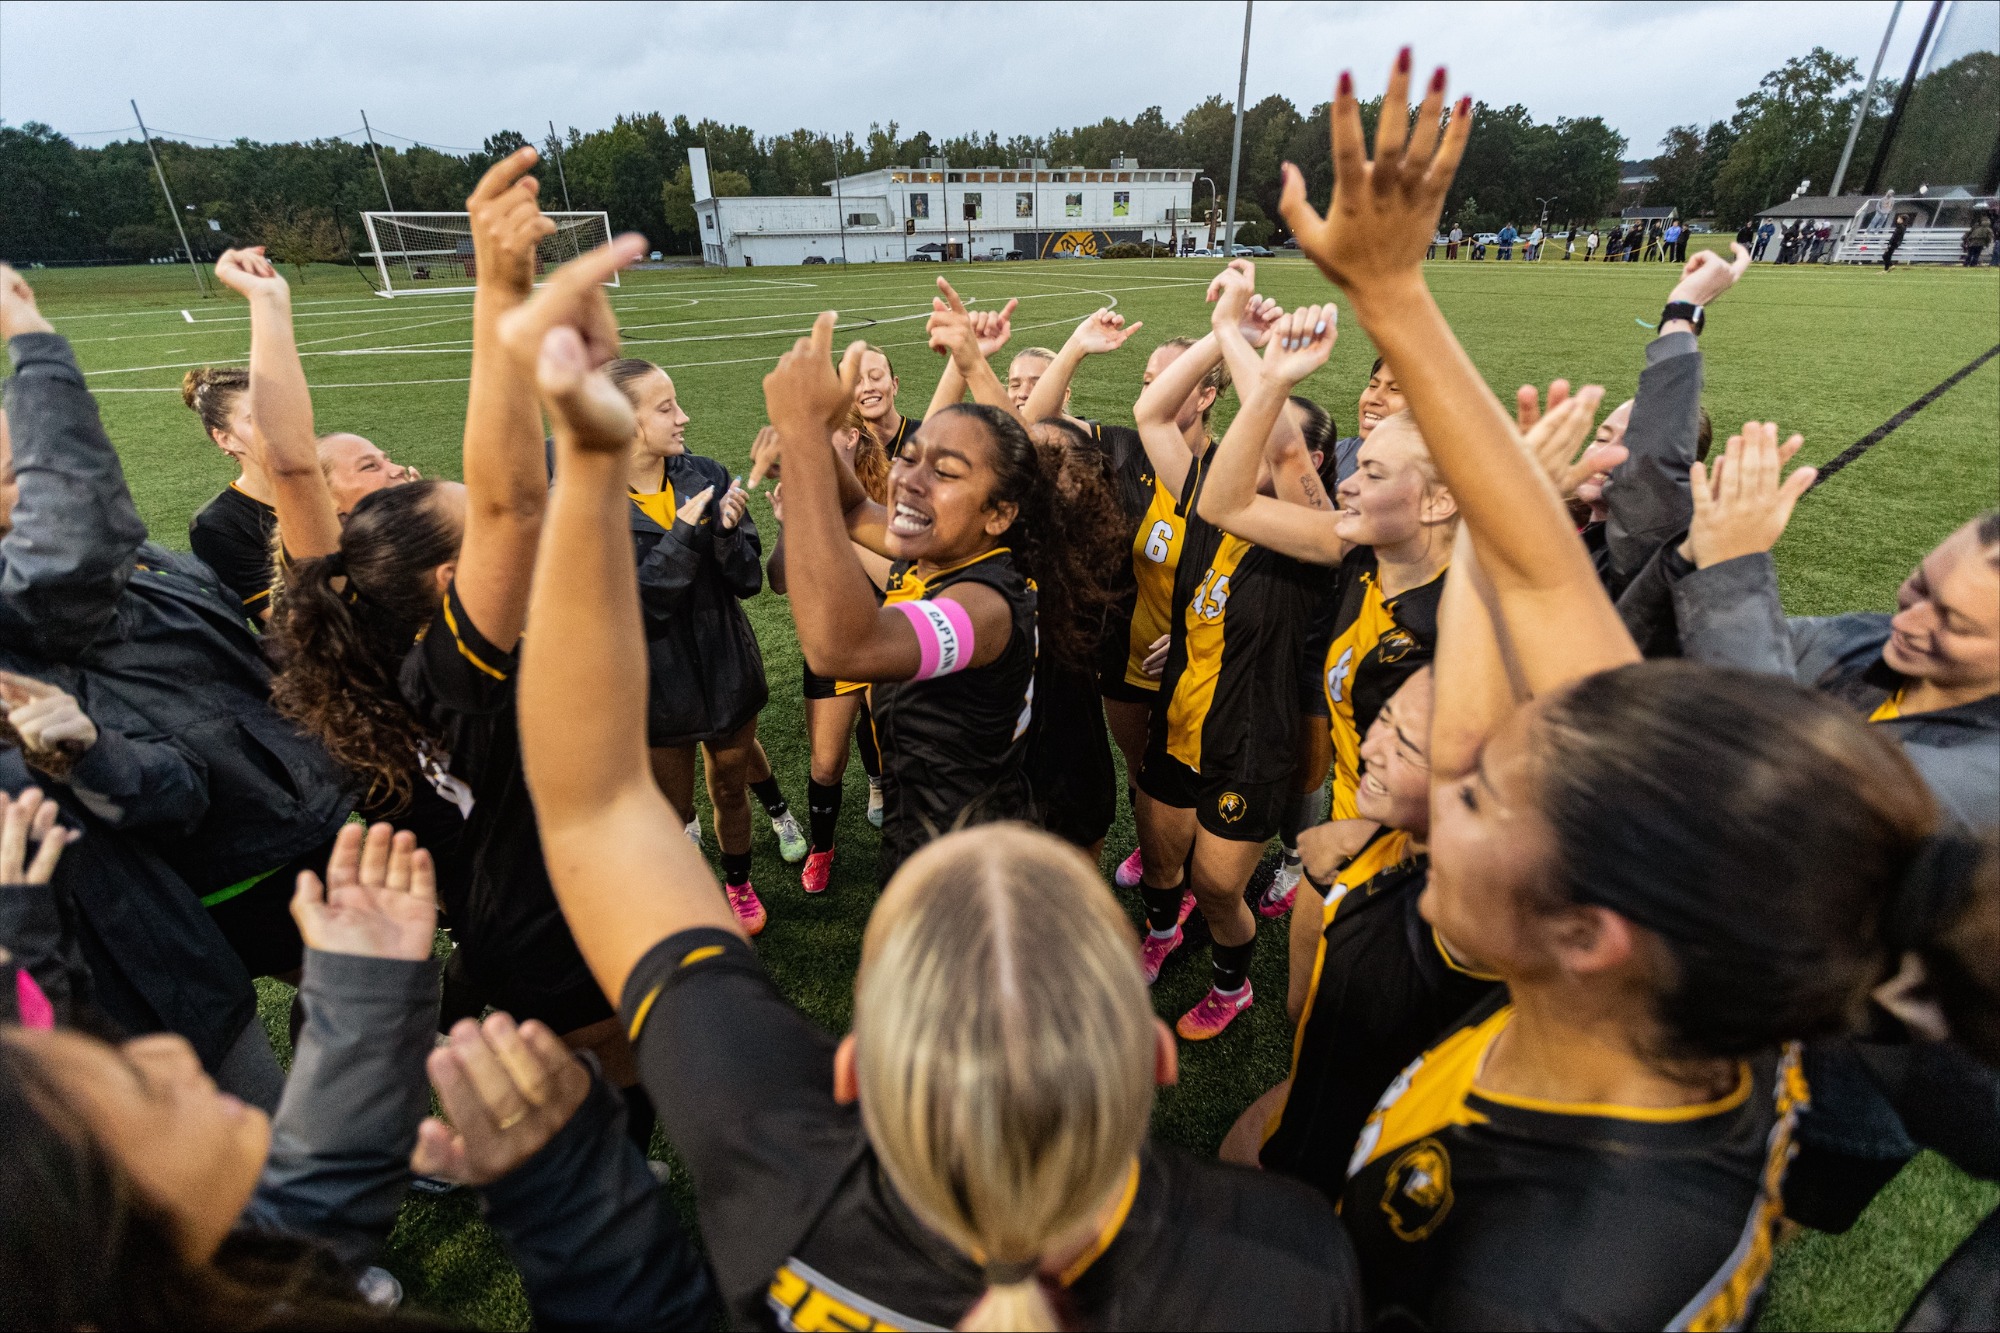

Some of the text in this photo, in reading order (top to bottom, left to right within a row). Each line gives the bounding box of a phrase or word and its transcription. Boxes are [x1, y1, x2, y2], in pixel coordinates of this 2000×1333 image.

[1144, 519, 1174, 564] 6
[1192, 568, 1230, 619] 15
[929, 611, 956, 670] CAPTAIN
